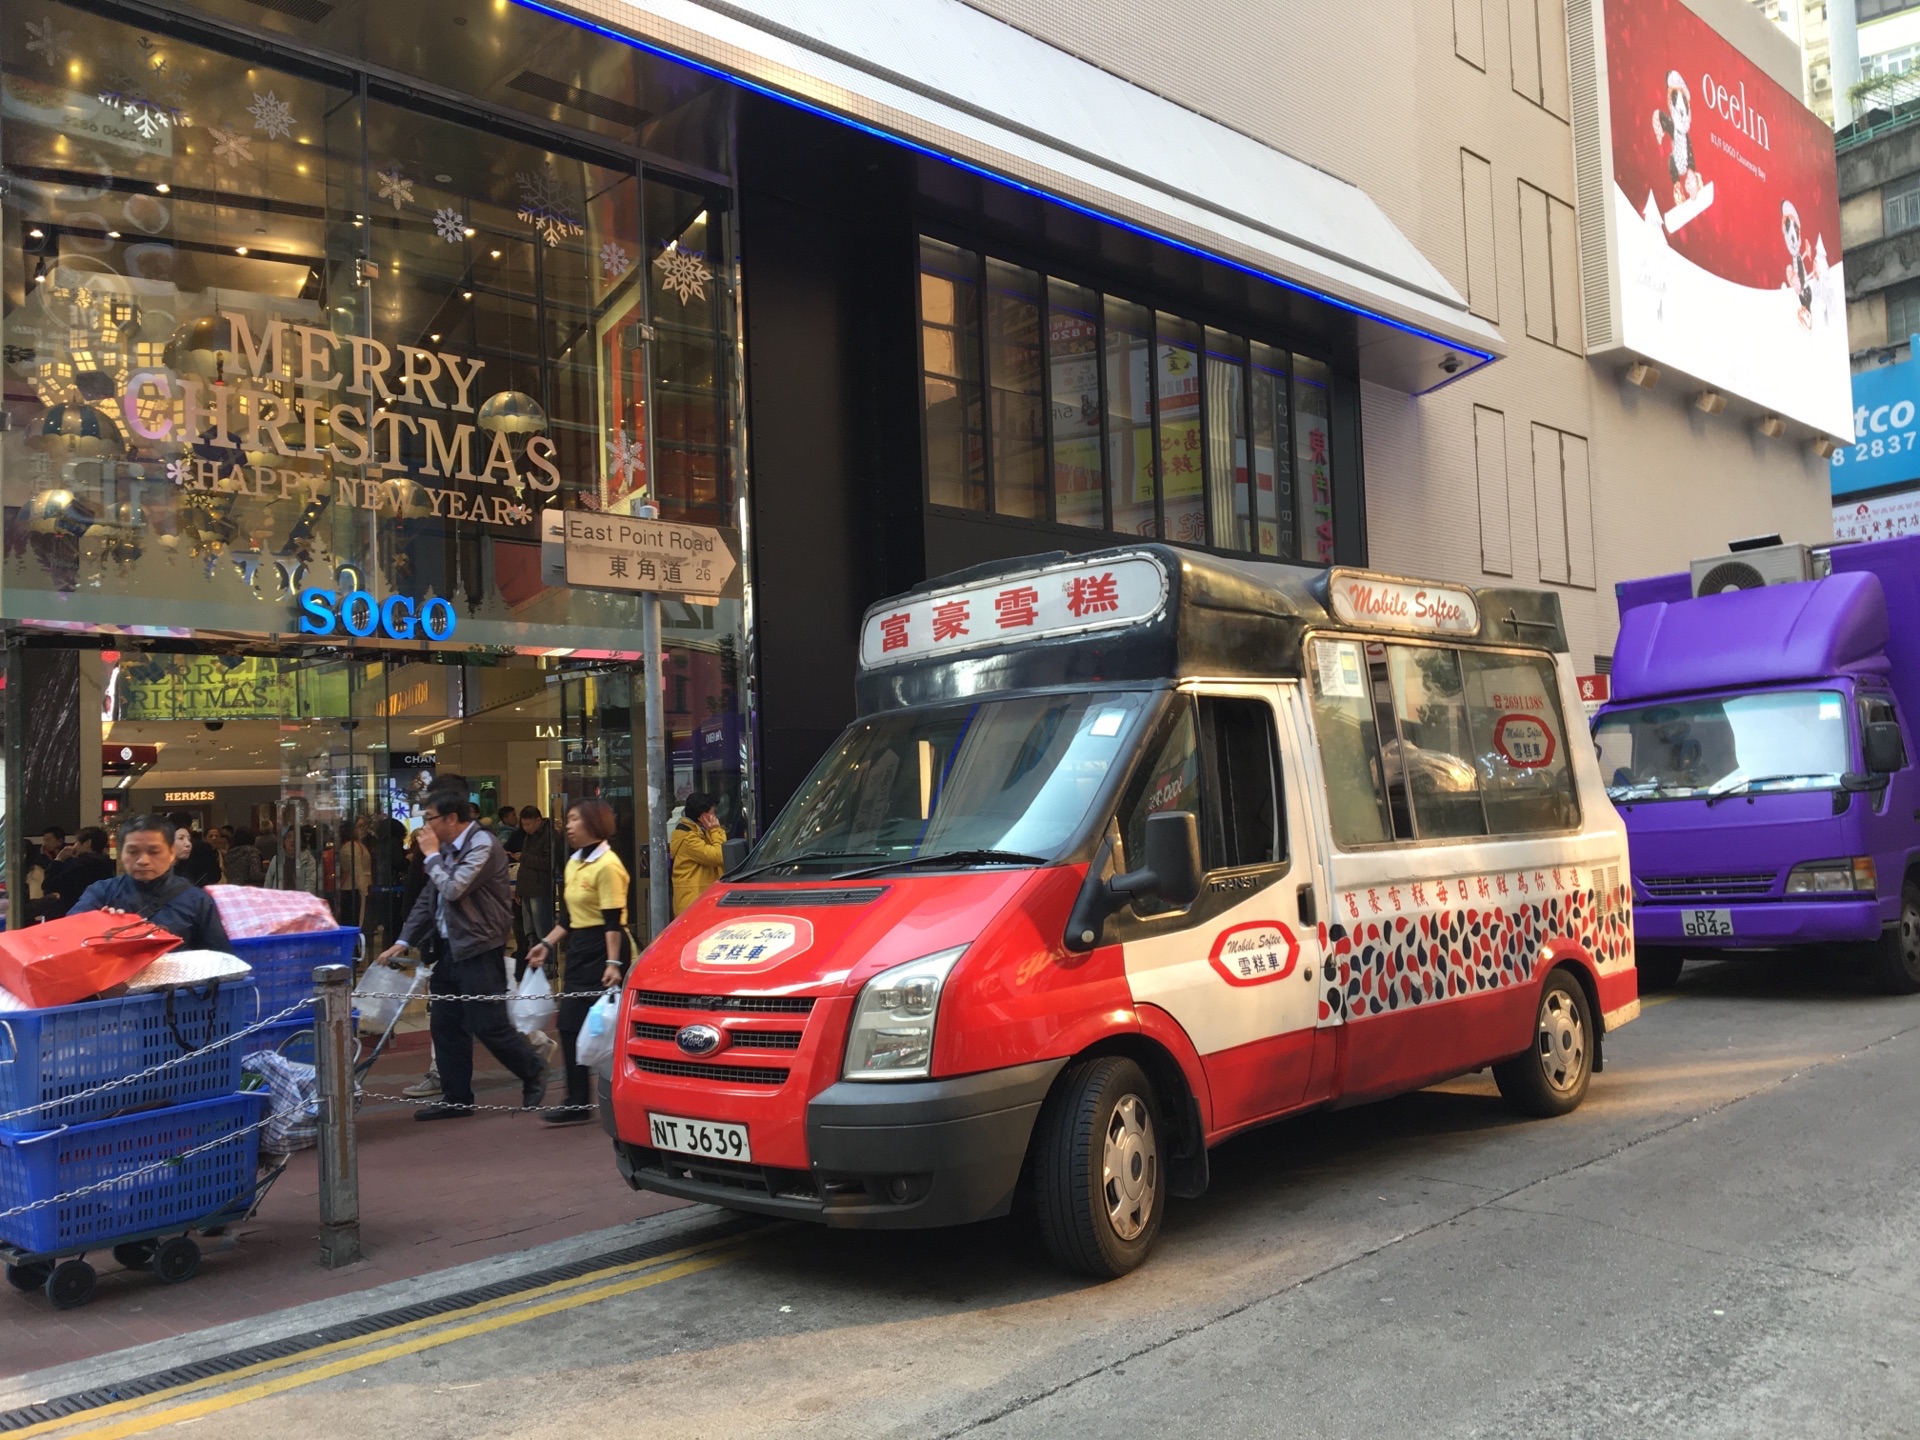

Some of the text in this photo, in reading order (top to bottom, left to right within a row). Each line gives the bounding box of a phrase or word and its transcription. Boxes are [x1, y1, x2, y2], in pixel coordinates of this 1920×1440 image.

[1722, 140, 1736, 158] SOGO
[1736, 150, 1758, 176] Causeway
[221, 311, 486, 414] MERRY
[124, 372, 561, 493] CHRISTMAS
[1854, 399, 1916, 438] tco
[1831, 431, 1917, 467] 8 2837
[193, 459, 327, 503] HAPPY
[336, 477, 413, 514] NEW
[425, 487, 514, 526] YEAR
[570, 520, 612, 542] East
[620, 526, 664, 547] Point
[669, 531, 714, 552] Road
[609, 555, 683, 584] 東角道
[695, 568, 711, 581] 26
[301, 586, 458, 641] SOGO
[880, 572, 1119, 653] 富豪雪糕
[1349, 584, 1461, 628] Mobile Softee
[1505, 726, 1542, 741] Mobile Softee
[404, 755, 436, 764] CHAN
[1210, 875, 1260, 893] TRANSIT
[1685, 922, 1731, 936] 9042
[1694, 910, 1717, 923] RZ
[714, 928, 791, 942] Mobile Softee
[1227, 933, 1281, 954] Mobile Softee
[706, 944, 767, 961] 雪糕車
[1238, 952, 1280, 976] 雪糕車
[682, 1031, 706, 1048] Ford
[653, 1120, 743, 1157] NT 3639
